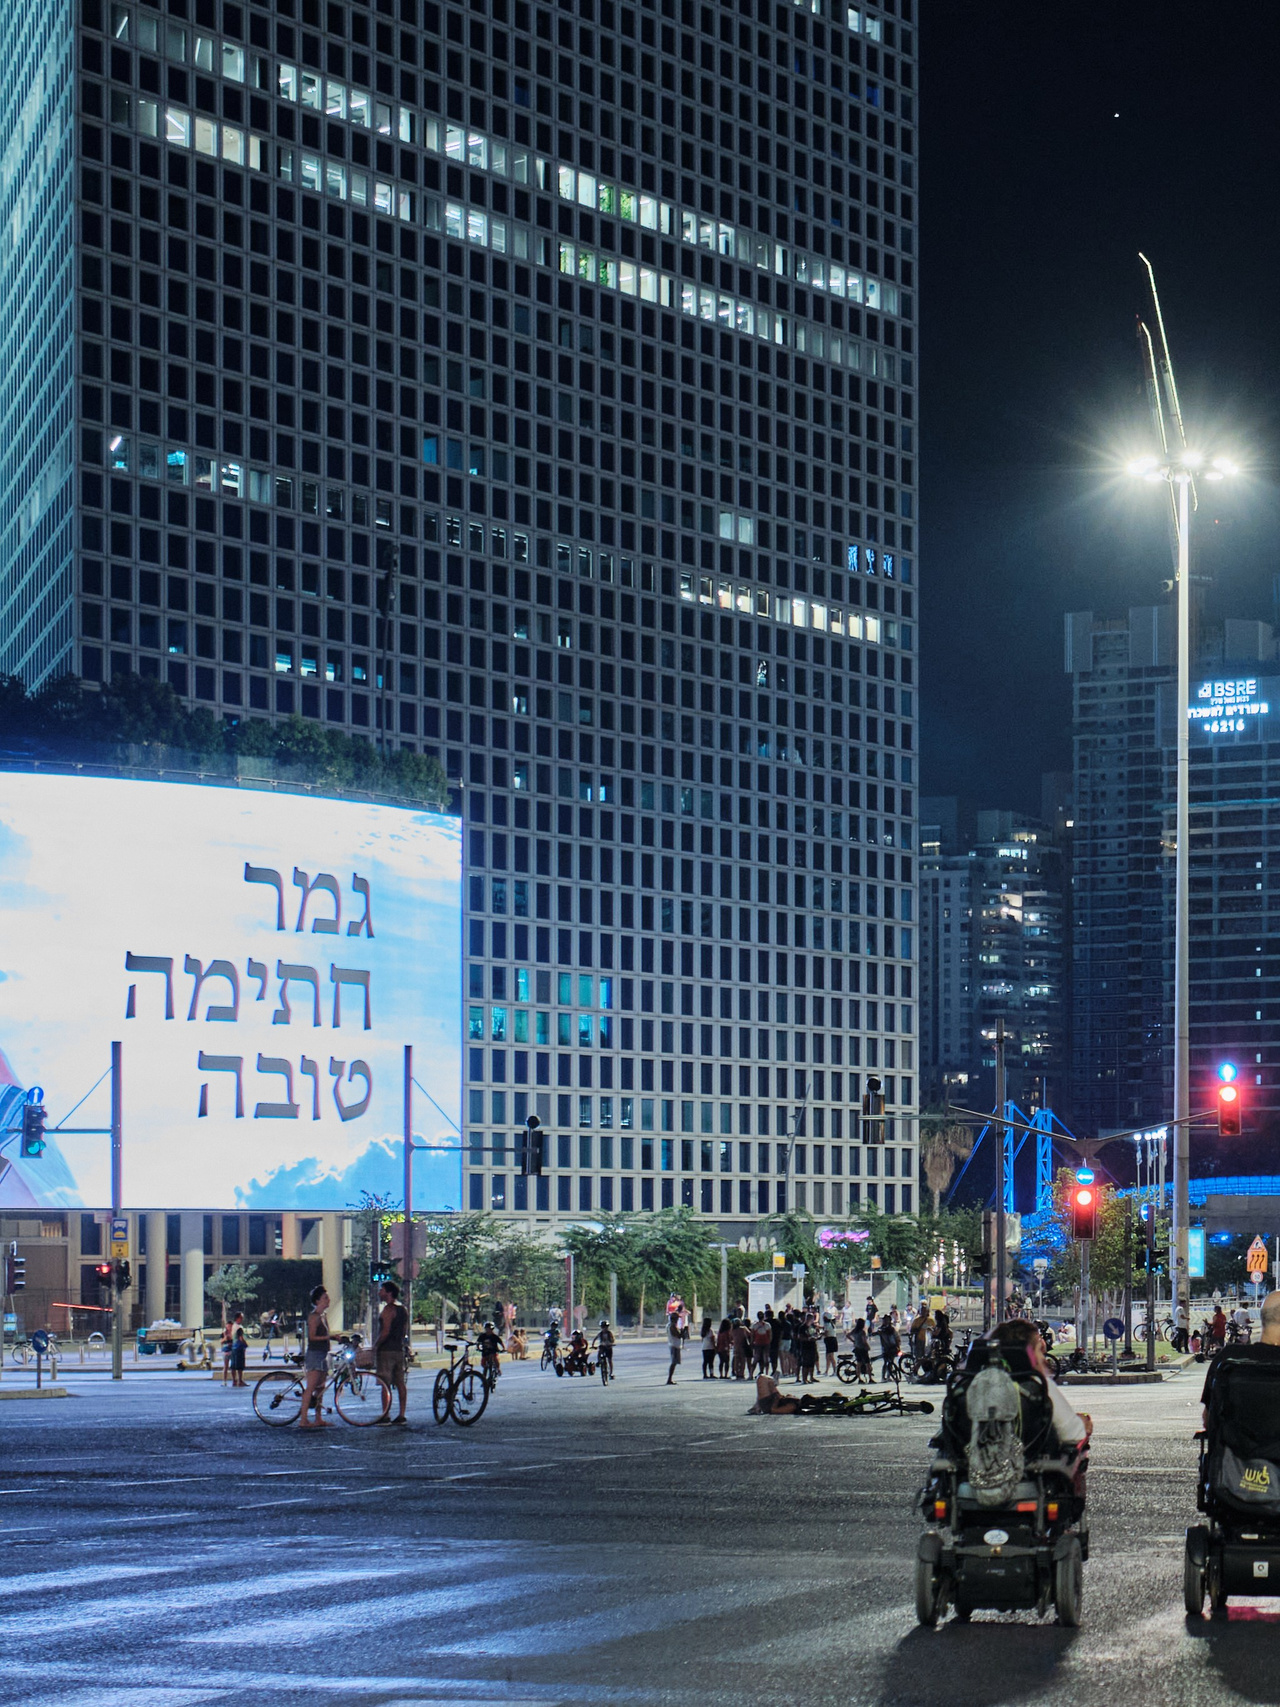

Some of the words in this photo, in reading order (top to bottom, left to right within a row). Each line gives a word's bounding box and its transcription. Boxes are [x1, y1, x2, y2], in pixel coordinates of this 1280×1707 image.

[1214, 680, 1256, 697] BSRE
[244, 862, 375, 939] גמר
[125, 951, 372, 1030] חתימה
[198, 1050, 374, 1122] טובה
